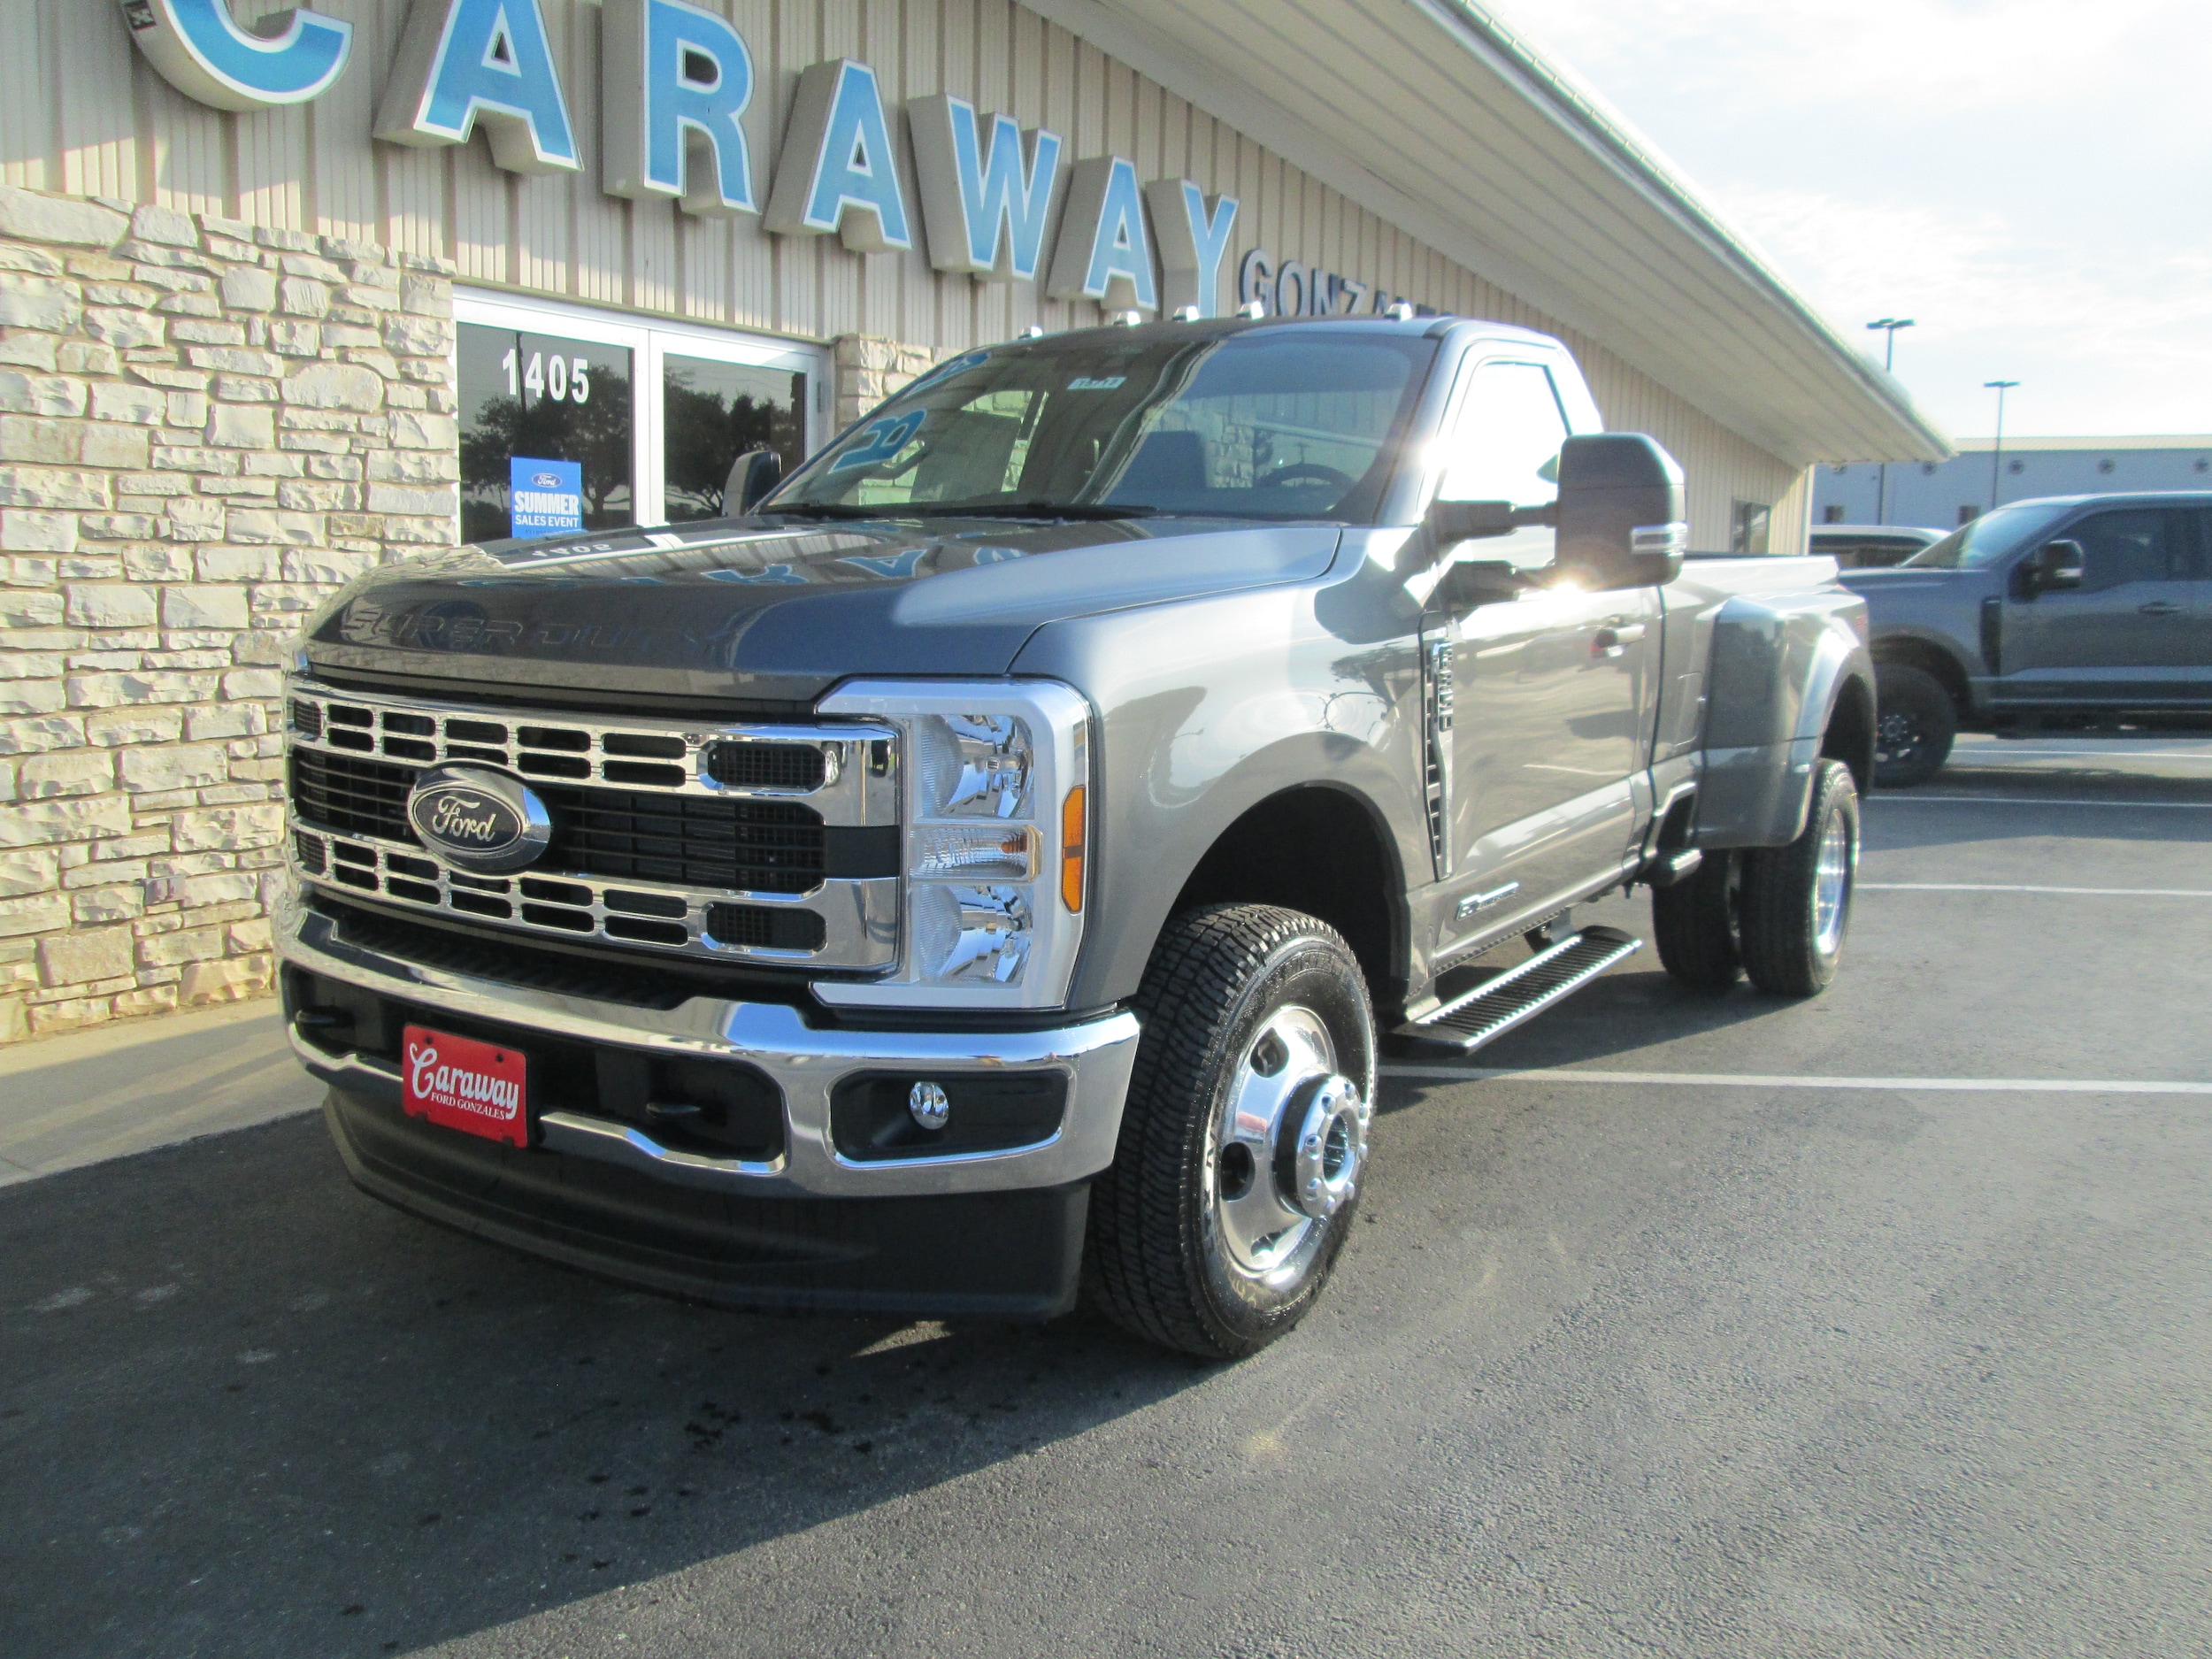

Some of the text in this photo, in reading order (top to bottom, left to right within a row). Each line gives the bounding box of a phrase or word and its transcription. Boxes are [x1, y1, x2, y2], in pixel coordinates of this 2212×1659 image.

[1240, 248, 1455, 316] GONZA
[502, 349, 590, 405] 1405
[536, 474, 557, 487] Ford
[514, 490, 580, 516] SUMMER
[515, 515, 580, 528] SALES EVENT
[432, 795, 497, 842] Ford
[409, 1042, 519, 1120] Caraway
[431, 1091, 506, 1121] FORD GONZALES
